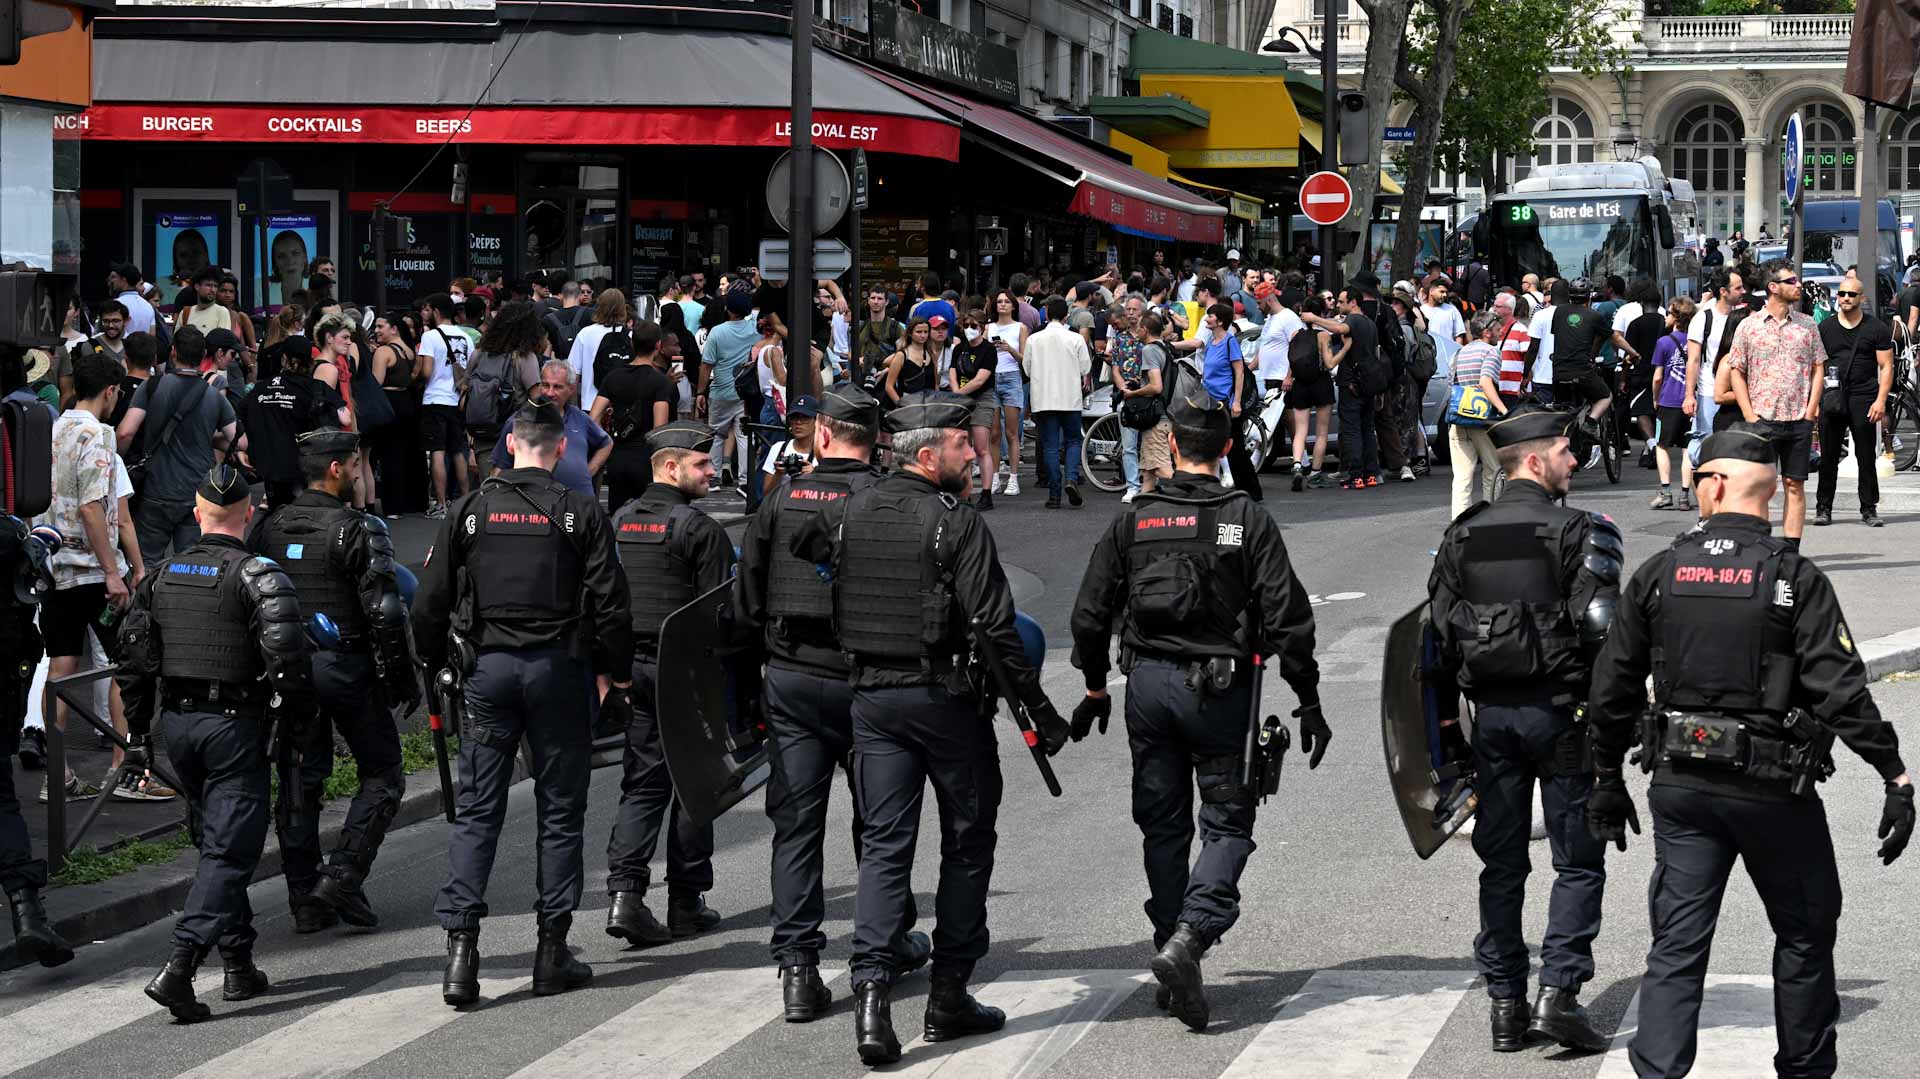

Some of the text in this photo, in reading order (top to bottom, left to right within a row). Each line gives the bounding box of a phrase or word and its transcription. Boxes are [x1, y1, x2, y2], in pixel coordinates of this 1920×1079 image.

[142, 117, 213, 131] BURGER
[268, 118, 362, 132] COCKTAILS
[416, 119, 472, 133] BEERS
[775, 122, 878, 140] LE OYAL EST
[1511, 203, 1621, 220] 38 Gare de l'Est
[394, 258, 435, 271] LIQUEURS
[790, 489, 818, 499] ALPHA
[489, 513, 518, 523] ALPHA
[1137, 516, 1196, 529] ALPHA 1-18/5
[169, 563, 190, 573] INDIA
